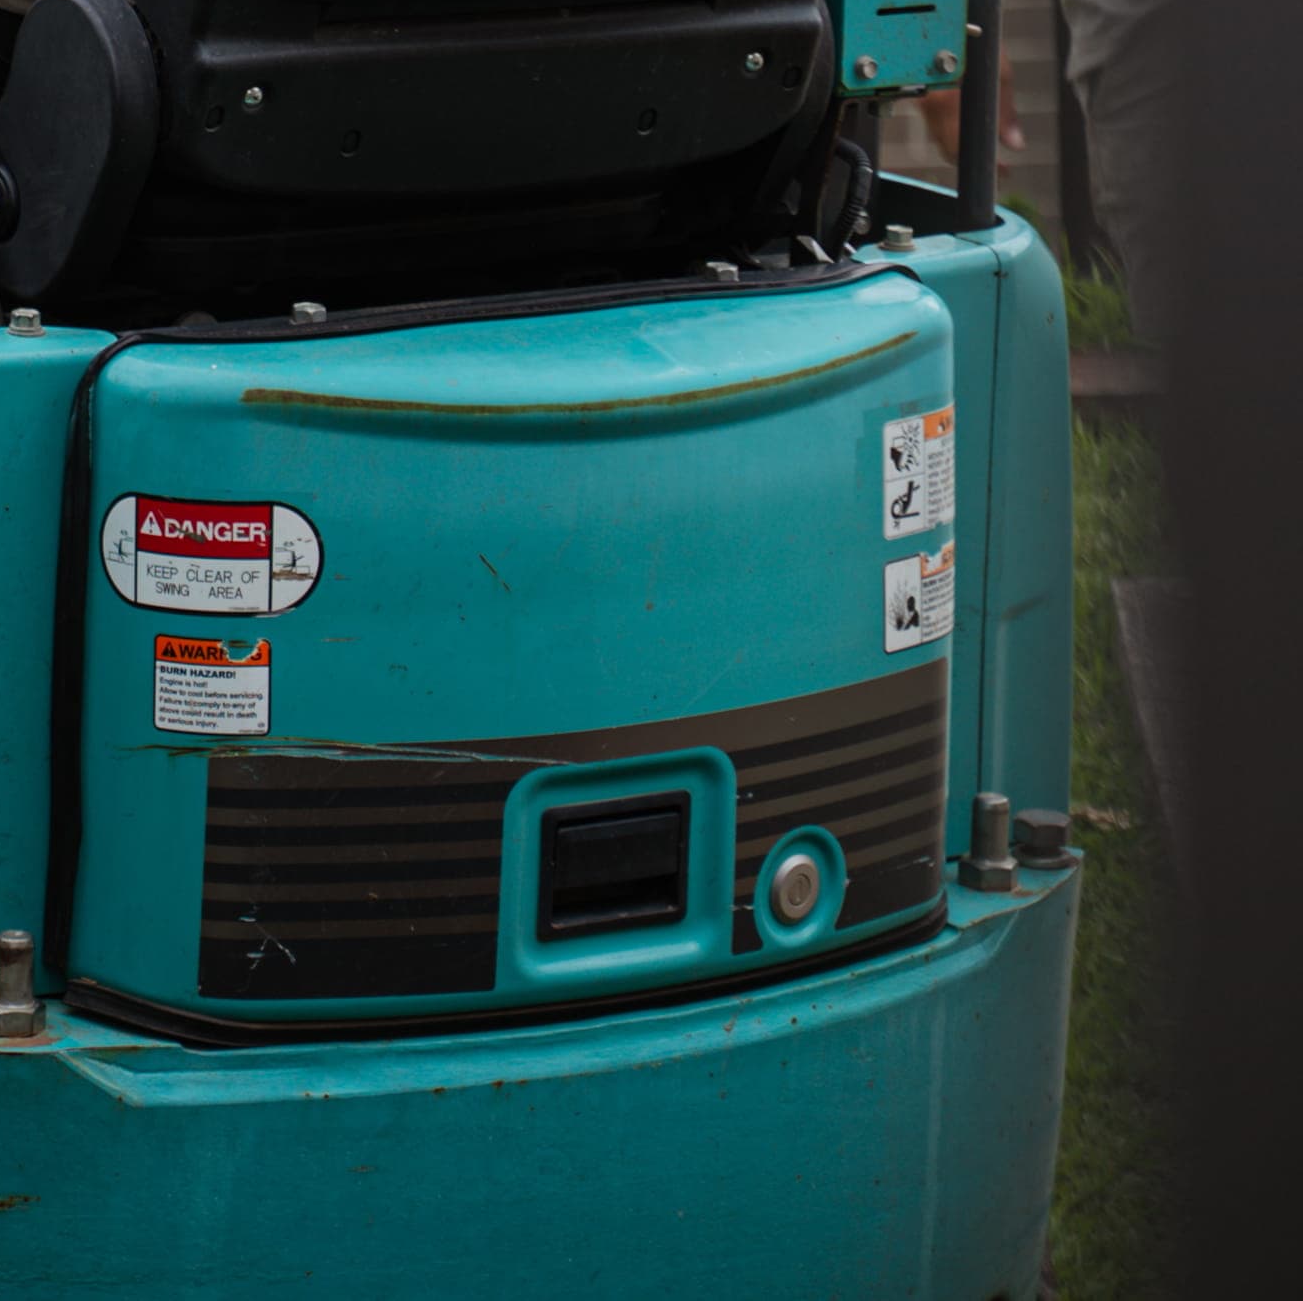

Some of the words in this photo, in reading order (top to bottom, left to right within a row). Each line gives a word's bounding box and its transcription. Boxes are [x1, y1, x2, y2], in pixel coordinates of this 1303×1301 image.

[164, 517, 267, 542] DANGER
[146, 564, 179, 579] KEEP
[186, 568, 233, 584] CLEAR
[240, 570, 261, 584] OF
[155, 581, 190, 597] SWING
[208, 586, 244, 600] AREA
[159, 665, 187, 675] BURN
[189, 667, 237, 679] HAZARD!
[159, 676, 184, 687] Engine
[184, 679, 192, 687] is
[159, 687, 178, 696] Allow
[187, 688, 203, 697] cool
[204, 689, 228, 698] before
[159, 696, 183, 705] Failure
[191, 698, 221, 709] comply
[248, 701, 256, 710] of
[159, 705, 180, 714] above
[235, 710, 258, 719] death
[167, 716, 194, 726] serious
